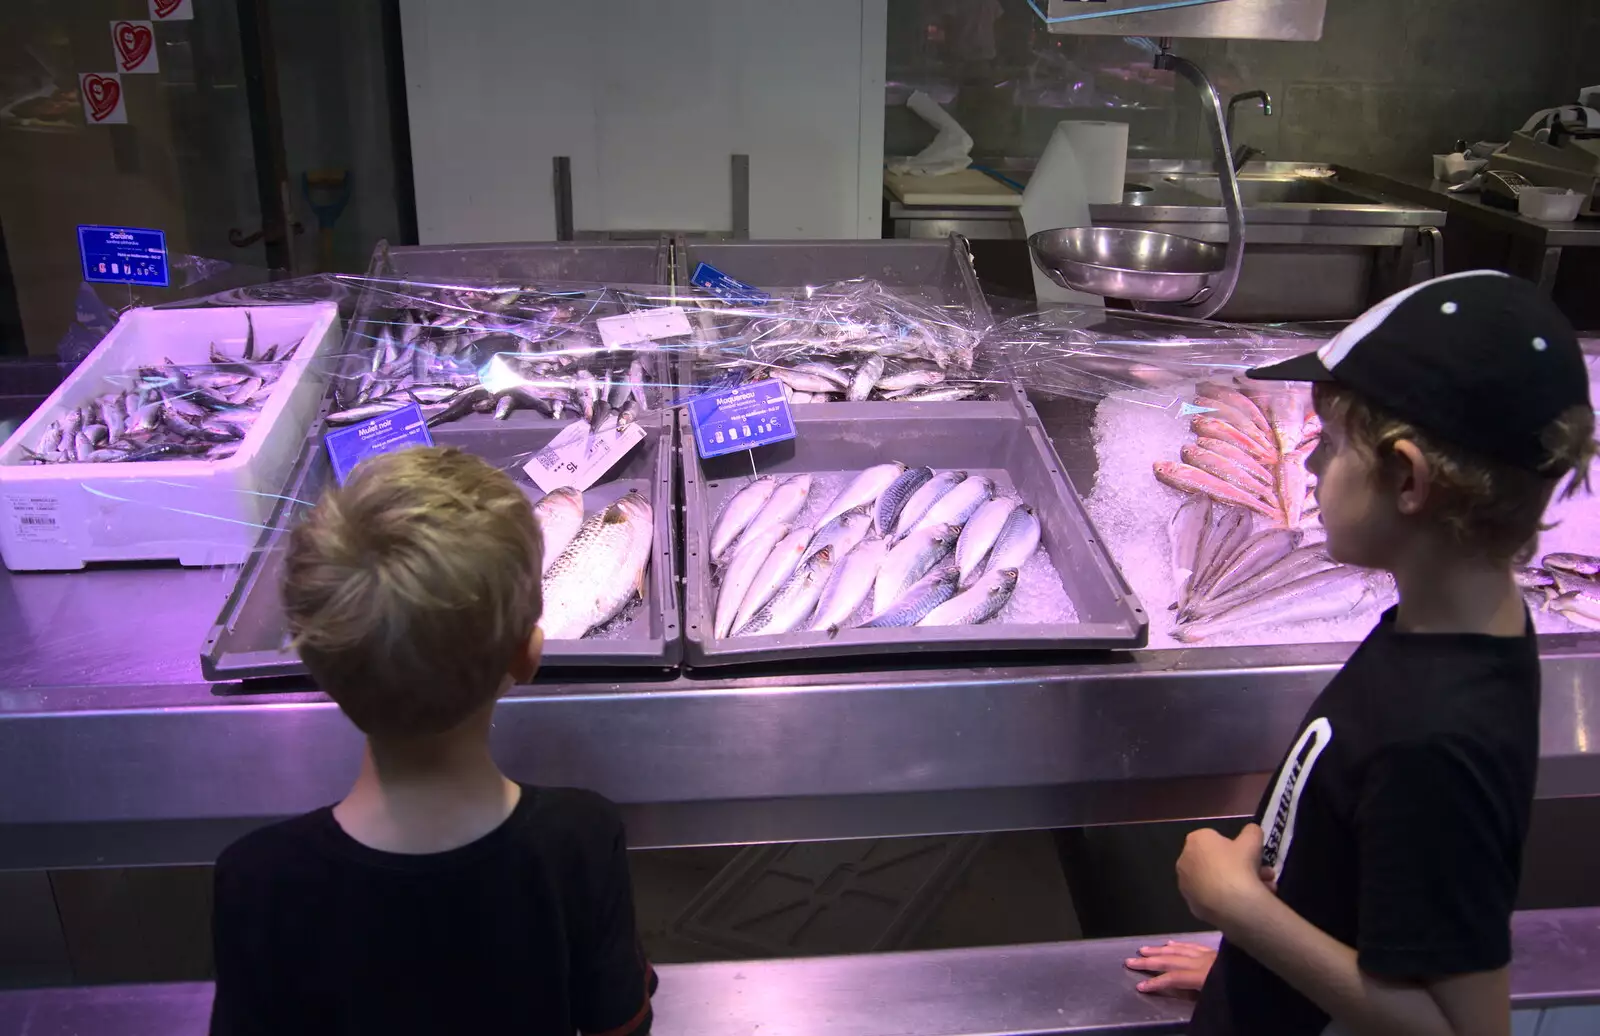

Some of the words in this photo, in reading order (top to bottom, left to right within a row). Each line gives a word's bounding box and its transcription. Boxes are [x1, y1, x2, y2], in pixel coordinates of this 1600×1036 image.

[110, 232, 133, 240] Sardine
[716, 392, 756, 406] Maquereau
[358, 424, 378, 436] Mulet
[378, 419, 392, 429] noir
[566, 461, 578, 474] 15
